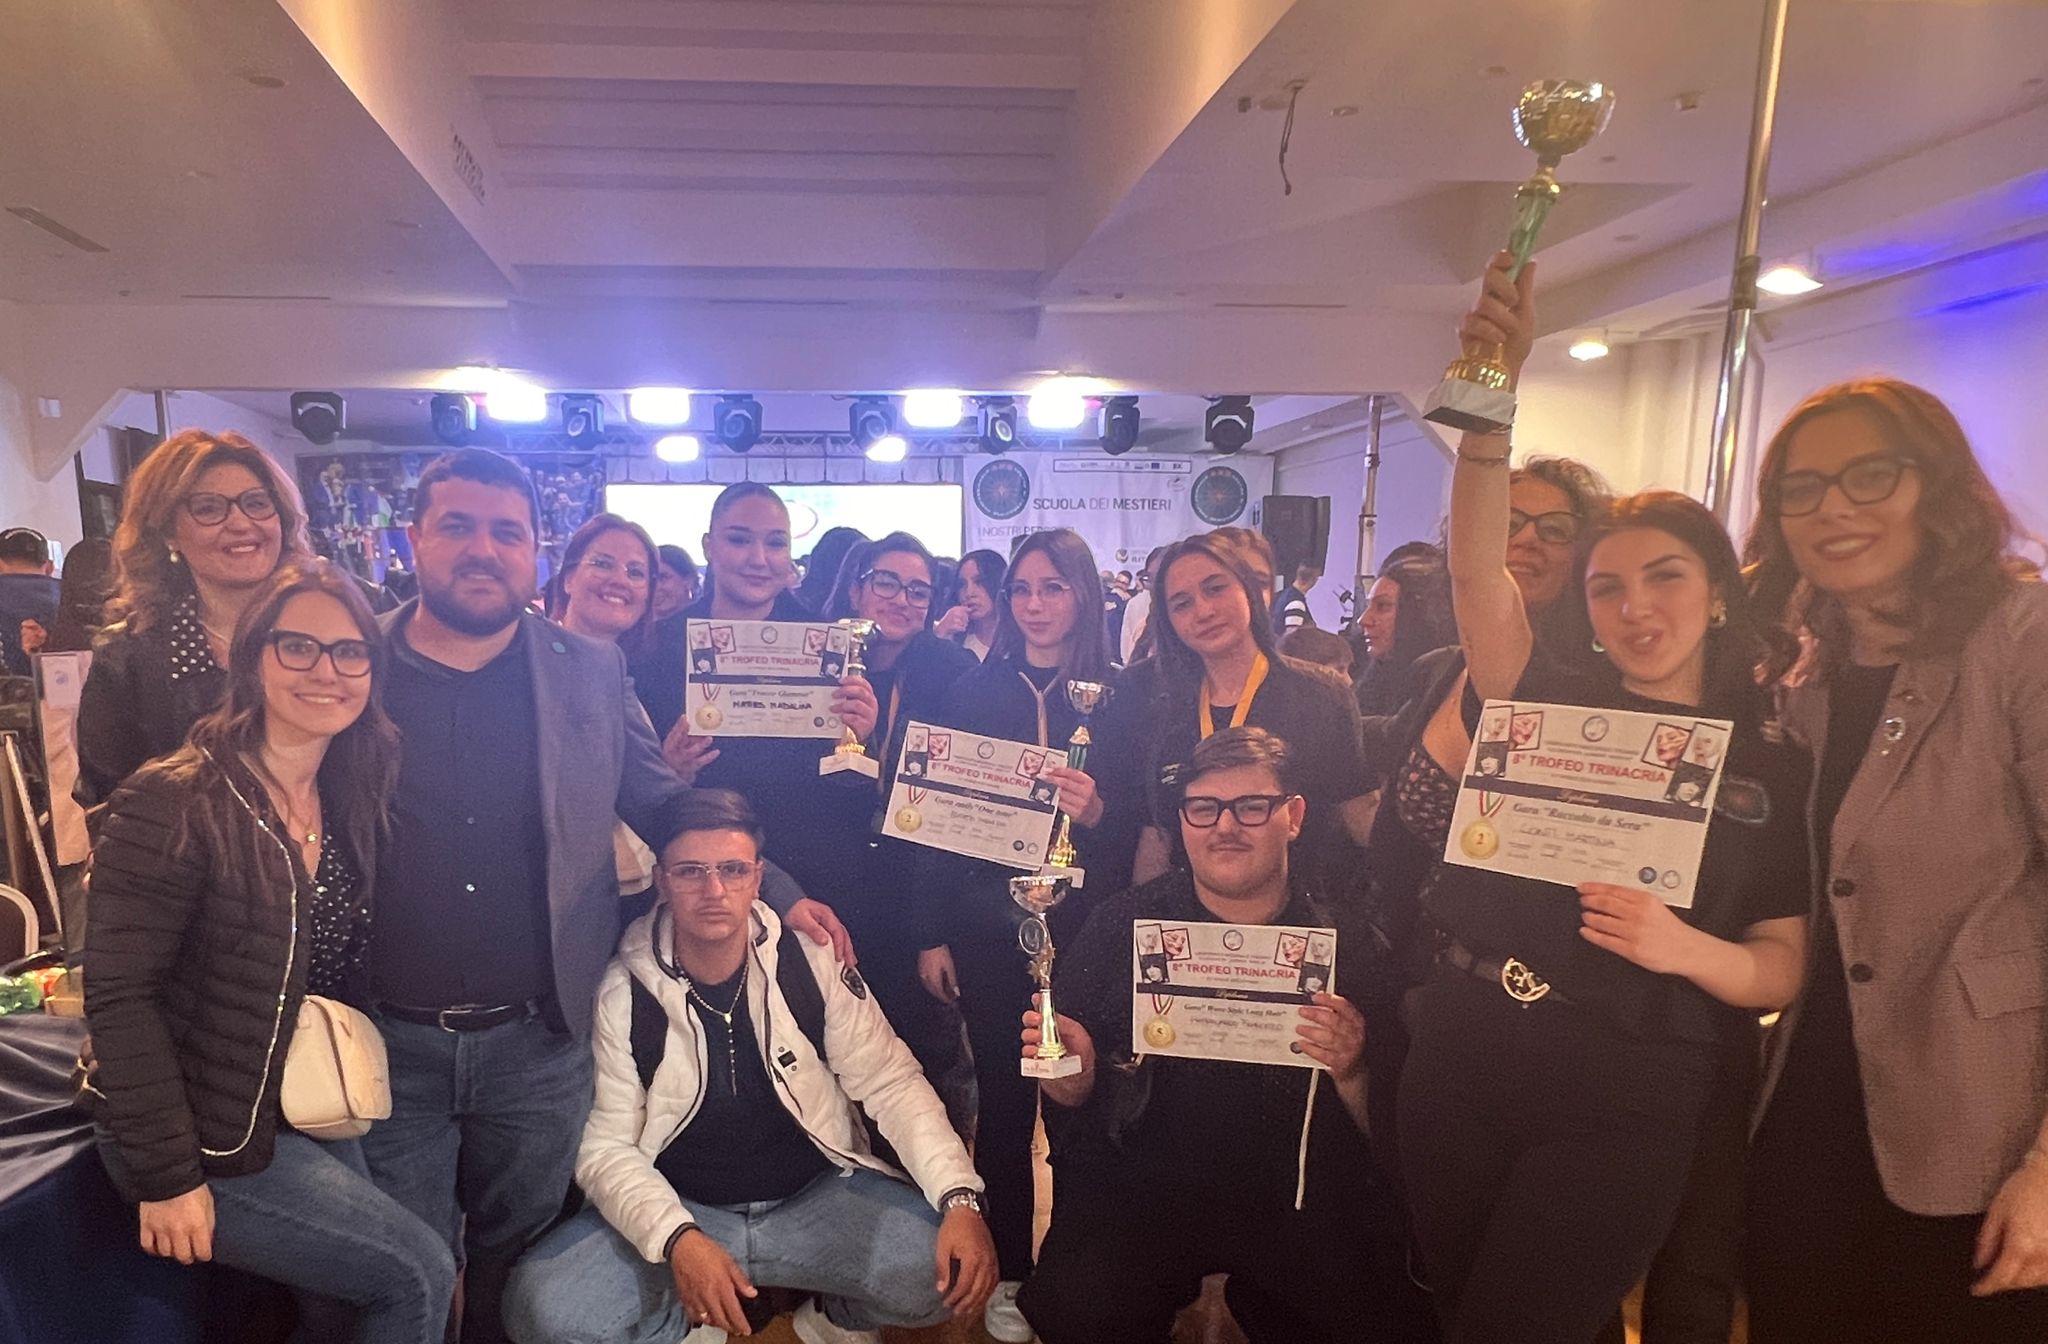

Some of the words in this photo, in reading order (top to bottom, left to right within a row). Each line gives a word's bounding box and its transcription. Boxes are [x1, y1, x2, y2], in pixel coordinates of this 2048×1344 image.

[1032, 497, 1087, 511] SCUOLA
[1089, 497, 1109, 510] DEI
[1112, 497, 1172, 511] MESTIERI
[982, 526, 1022, 537] NOSTRI
[731, 655, 769, 665] TROFEO
[771, 656, 820, 666] TRINACRIA
[943, 763, 980, 778] TROFEO
[982, 772, 1031, 788] TRINACRIA
[1530, 755, 1584, 772] TROFEO
[1588, 762, 1667, 783] TRINACRIA
[1513, 802, 1539, 815] Gara
[1475, 832, 1484, 845] 2
[1186, 963, 1231, 975] TROFEO
[1234, 966, 1296, 979] TRINACRIA
